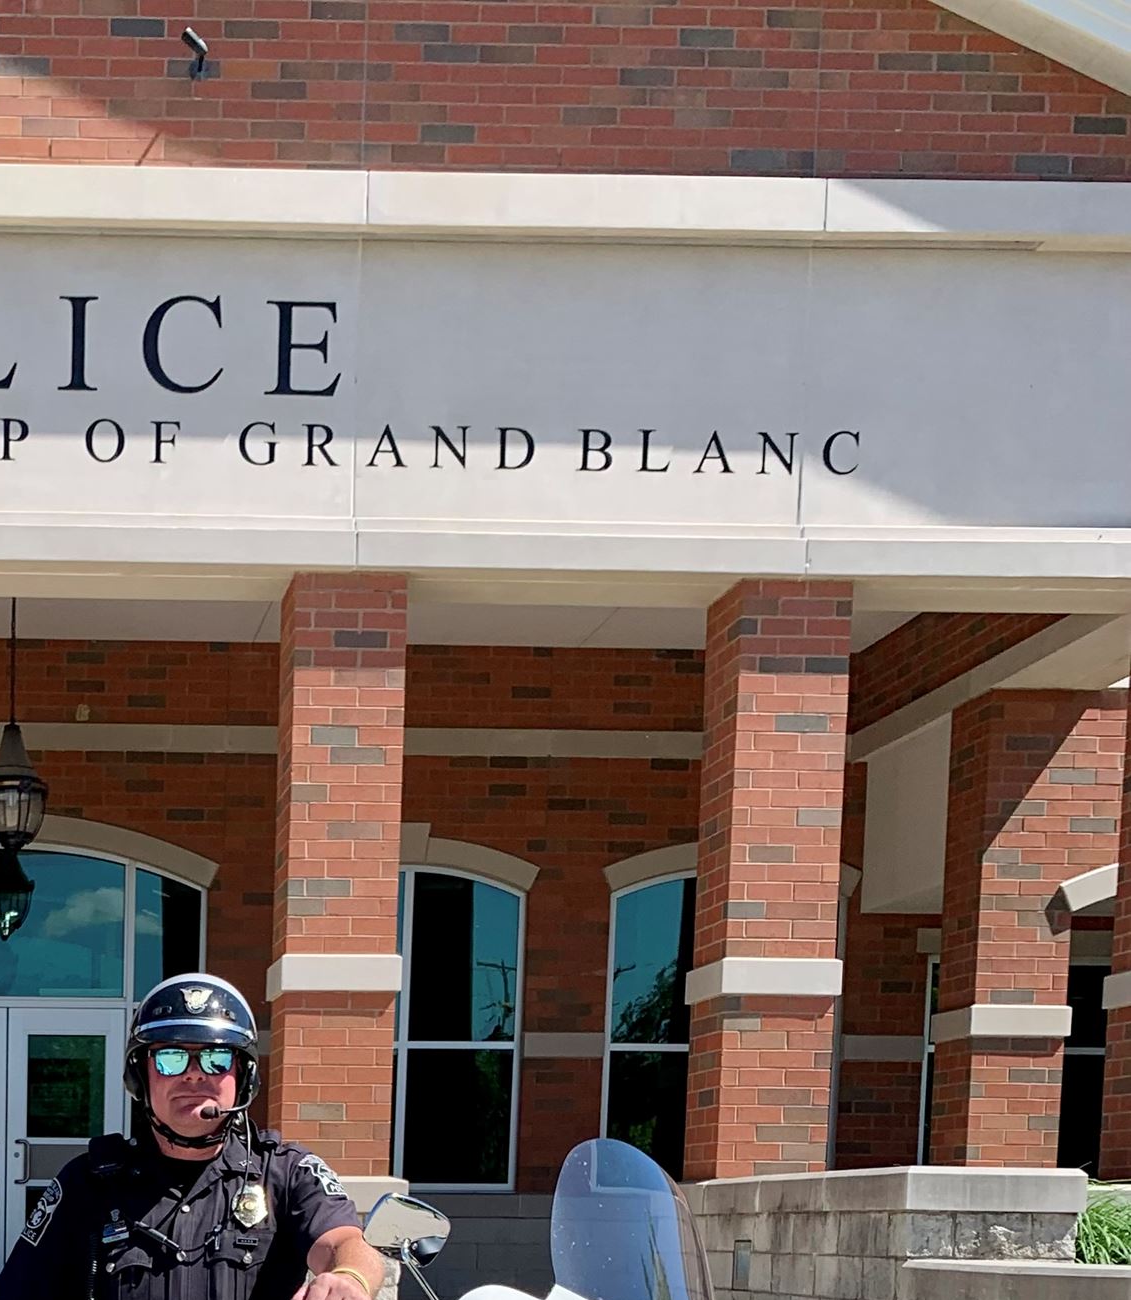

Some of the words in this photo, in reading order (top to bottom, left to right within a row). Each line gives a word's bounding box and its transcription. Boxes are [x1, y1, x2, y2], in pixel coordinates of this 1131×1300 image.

[85, 418, 181, 464] OF
[238, 421, 536, 471] GRAND
[578, 428, 861, 477] BLANC
